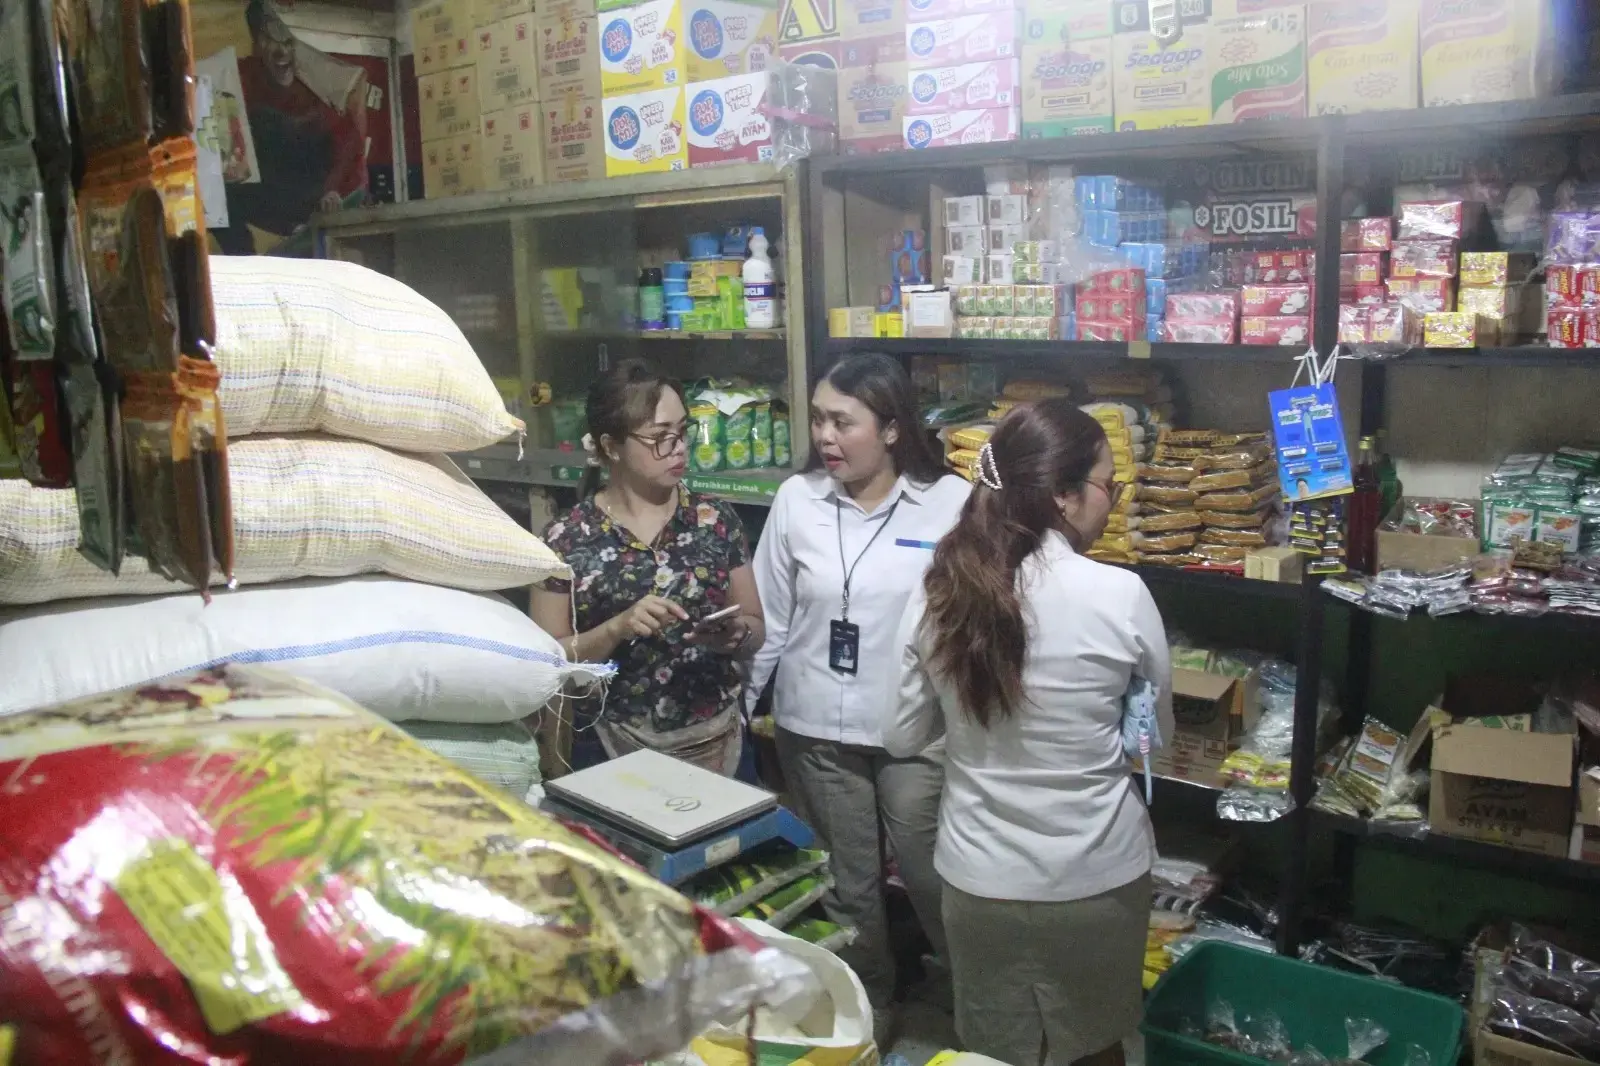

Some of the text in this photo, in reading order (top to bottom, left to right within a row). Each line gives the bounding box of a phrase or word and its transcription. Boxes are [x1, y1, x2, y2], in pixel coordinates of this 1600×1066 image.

[1228, 63, 1288, 83] Soto Mie
[742, 123, 765, 138] AYAM
[760, 149, 772, 158] 24
[1213, 203, 1294, 233] FOSIL
[692, 480, 760, 493] Bersihkan Lemak
